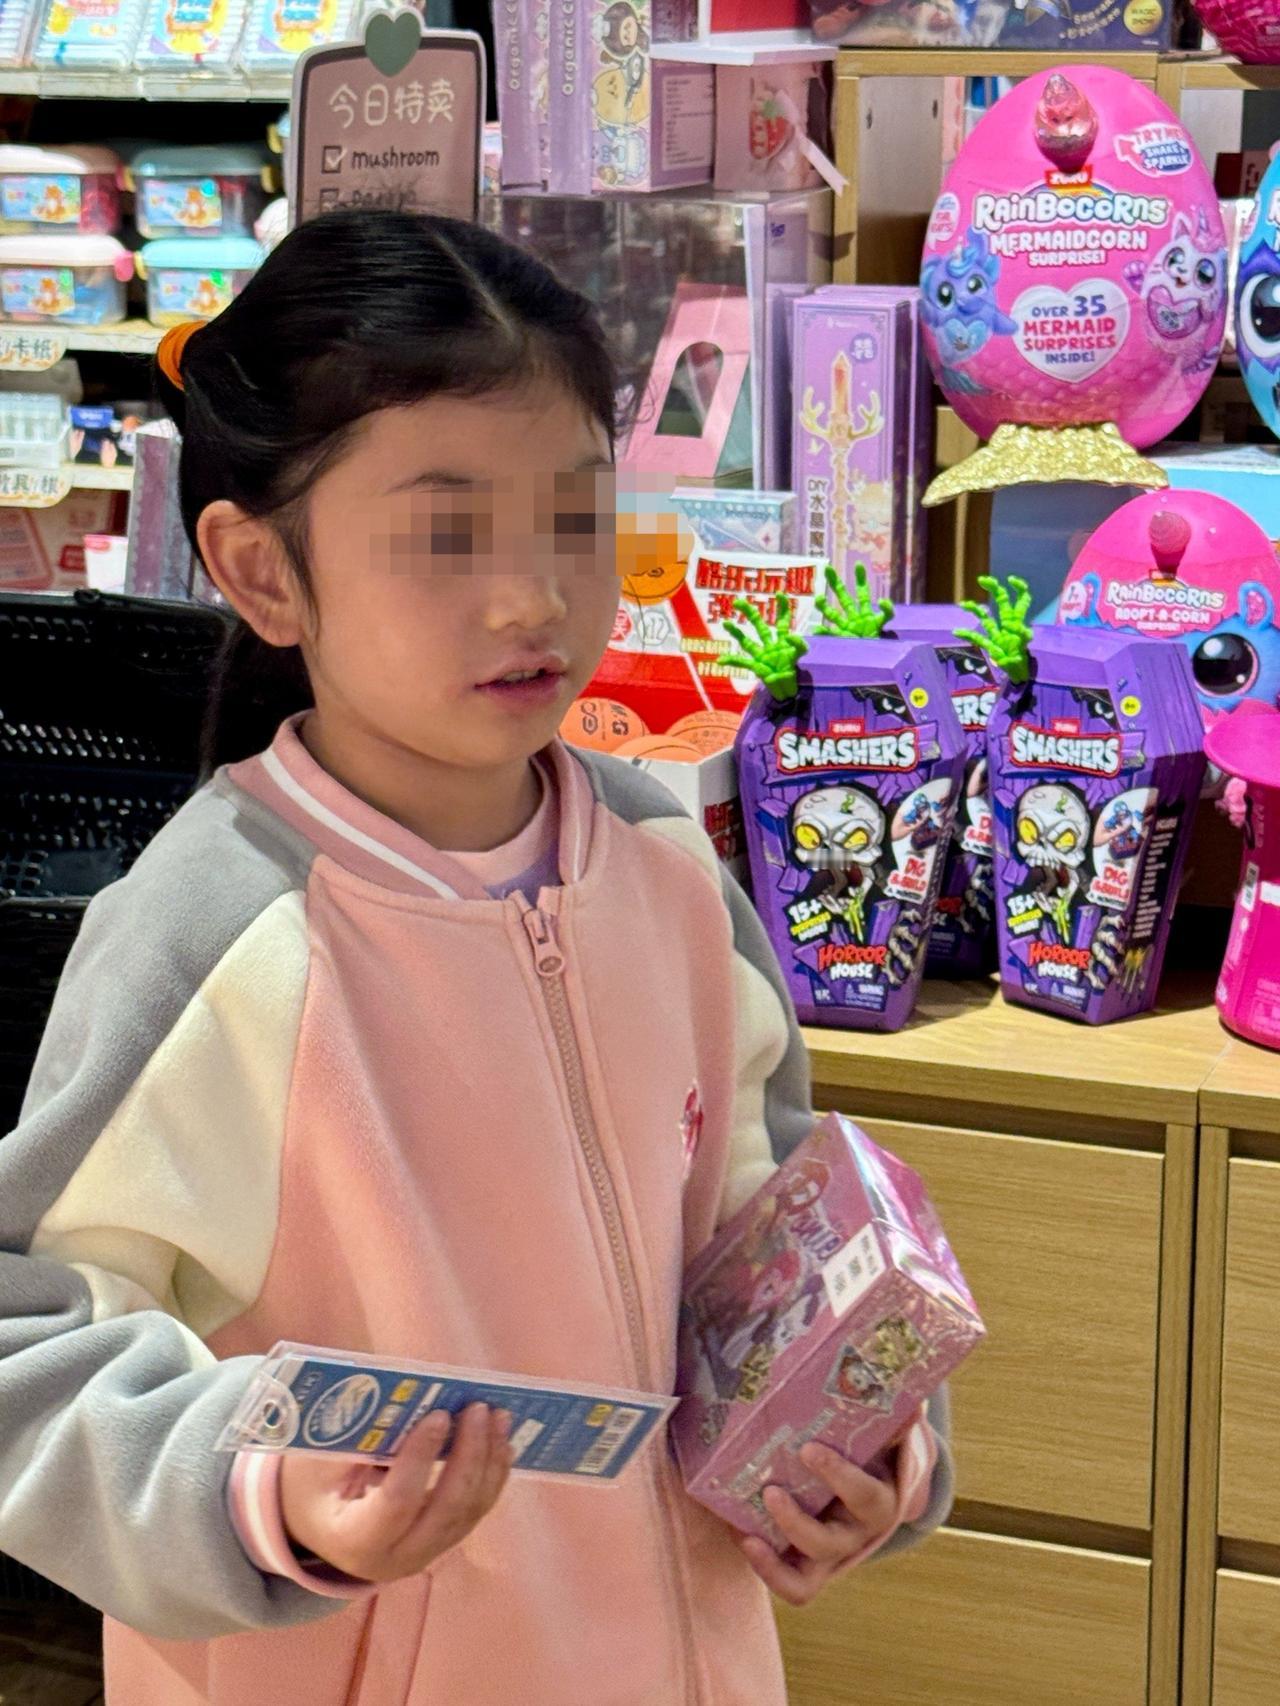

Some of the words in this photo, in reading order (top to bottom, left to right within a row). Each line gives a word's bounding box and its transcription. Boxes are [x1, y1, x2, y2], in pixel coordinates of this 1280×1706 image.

[562, 18, 578, 96] Organic
[329, 78, 456, 129] 今日特卖
[351, 145, 440, 169] mushroom
[990, 229, 1148, 257] MERMAIDCORN
[1031, 306, 1069, 318] OVER
[1073, 294, 1107, 317] 35
[1023, 317, 1117, 336] MERMAID
[1023, 335, 1117, 352] SURPRISES
[1045, 351, 1095, 364] INSIDE!
[808, 479, 827, 491] DIY
[780, 731, 916, 769] SMASHERS
[1012, 726, 1119, 773] SMASHERS
[788, 899, 822, 924] 15+
[1007, 894, 1036, 918] 15+
[818, 944, 887, 973] HORROR
[1028, 942, 1091, 969] HORROR
[830, 962, 874, 980] HOUSE
[1038, 960, 1079, 981] HOUSE
